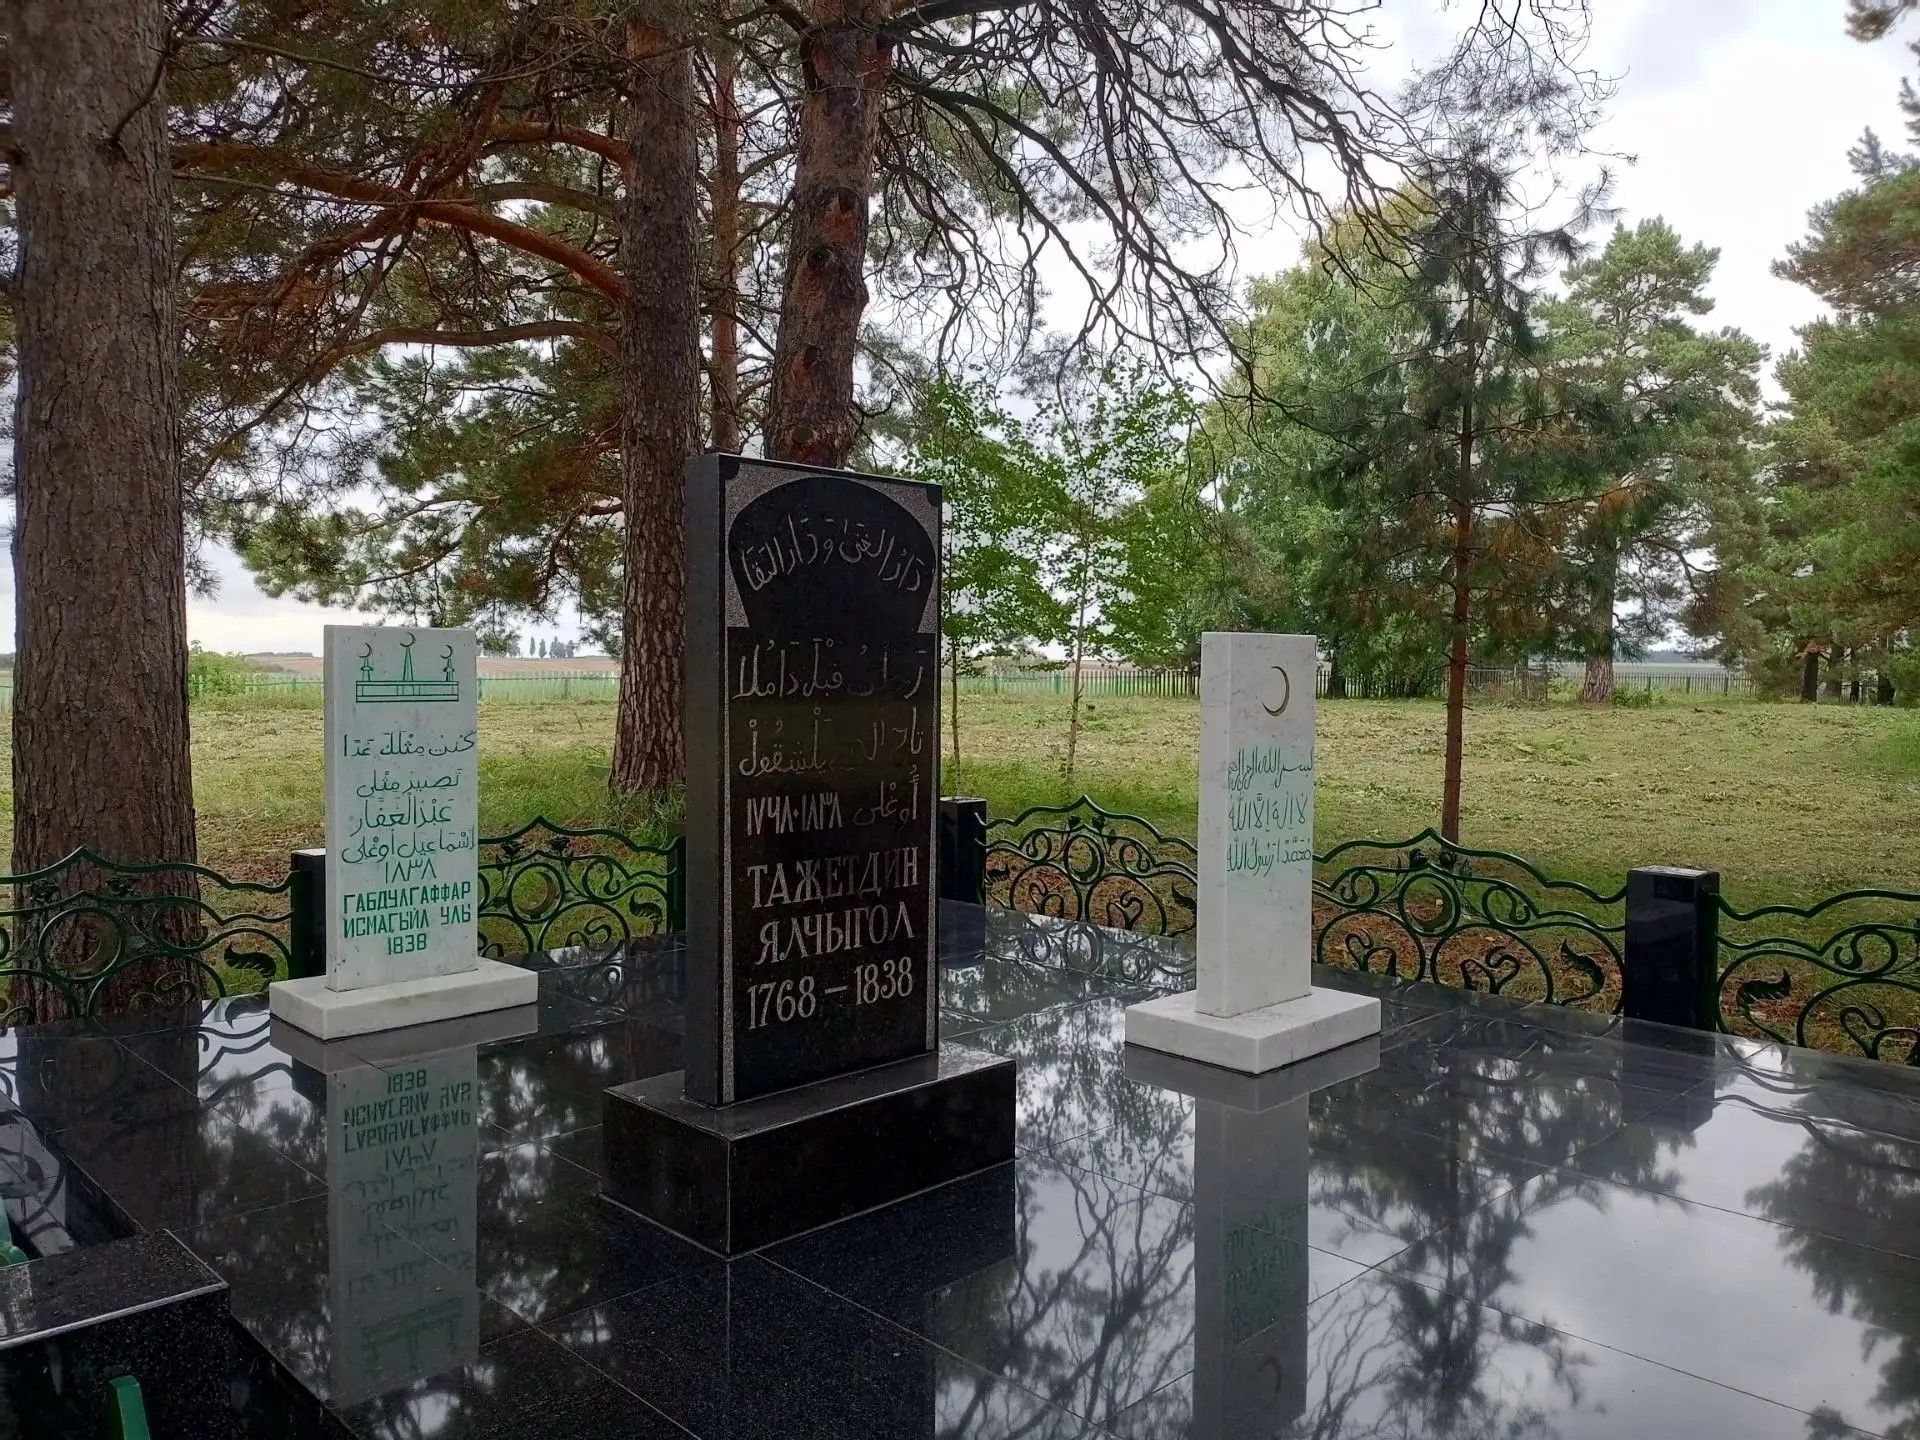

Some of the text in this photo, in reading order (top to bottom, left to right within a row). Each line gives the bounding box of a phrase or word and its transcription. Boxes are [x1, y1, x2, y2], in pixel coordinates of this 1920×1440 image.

[343, 881, 471, 914] ГАБДУЛГАФФАР
[387, 933, 427, 955] 1838
[755, 901, 916, 965] ЯЛЧЫГОЛ
[747, 975, 817, 1030] 1768
[854, 956, 914, 1006] 1838
